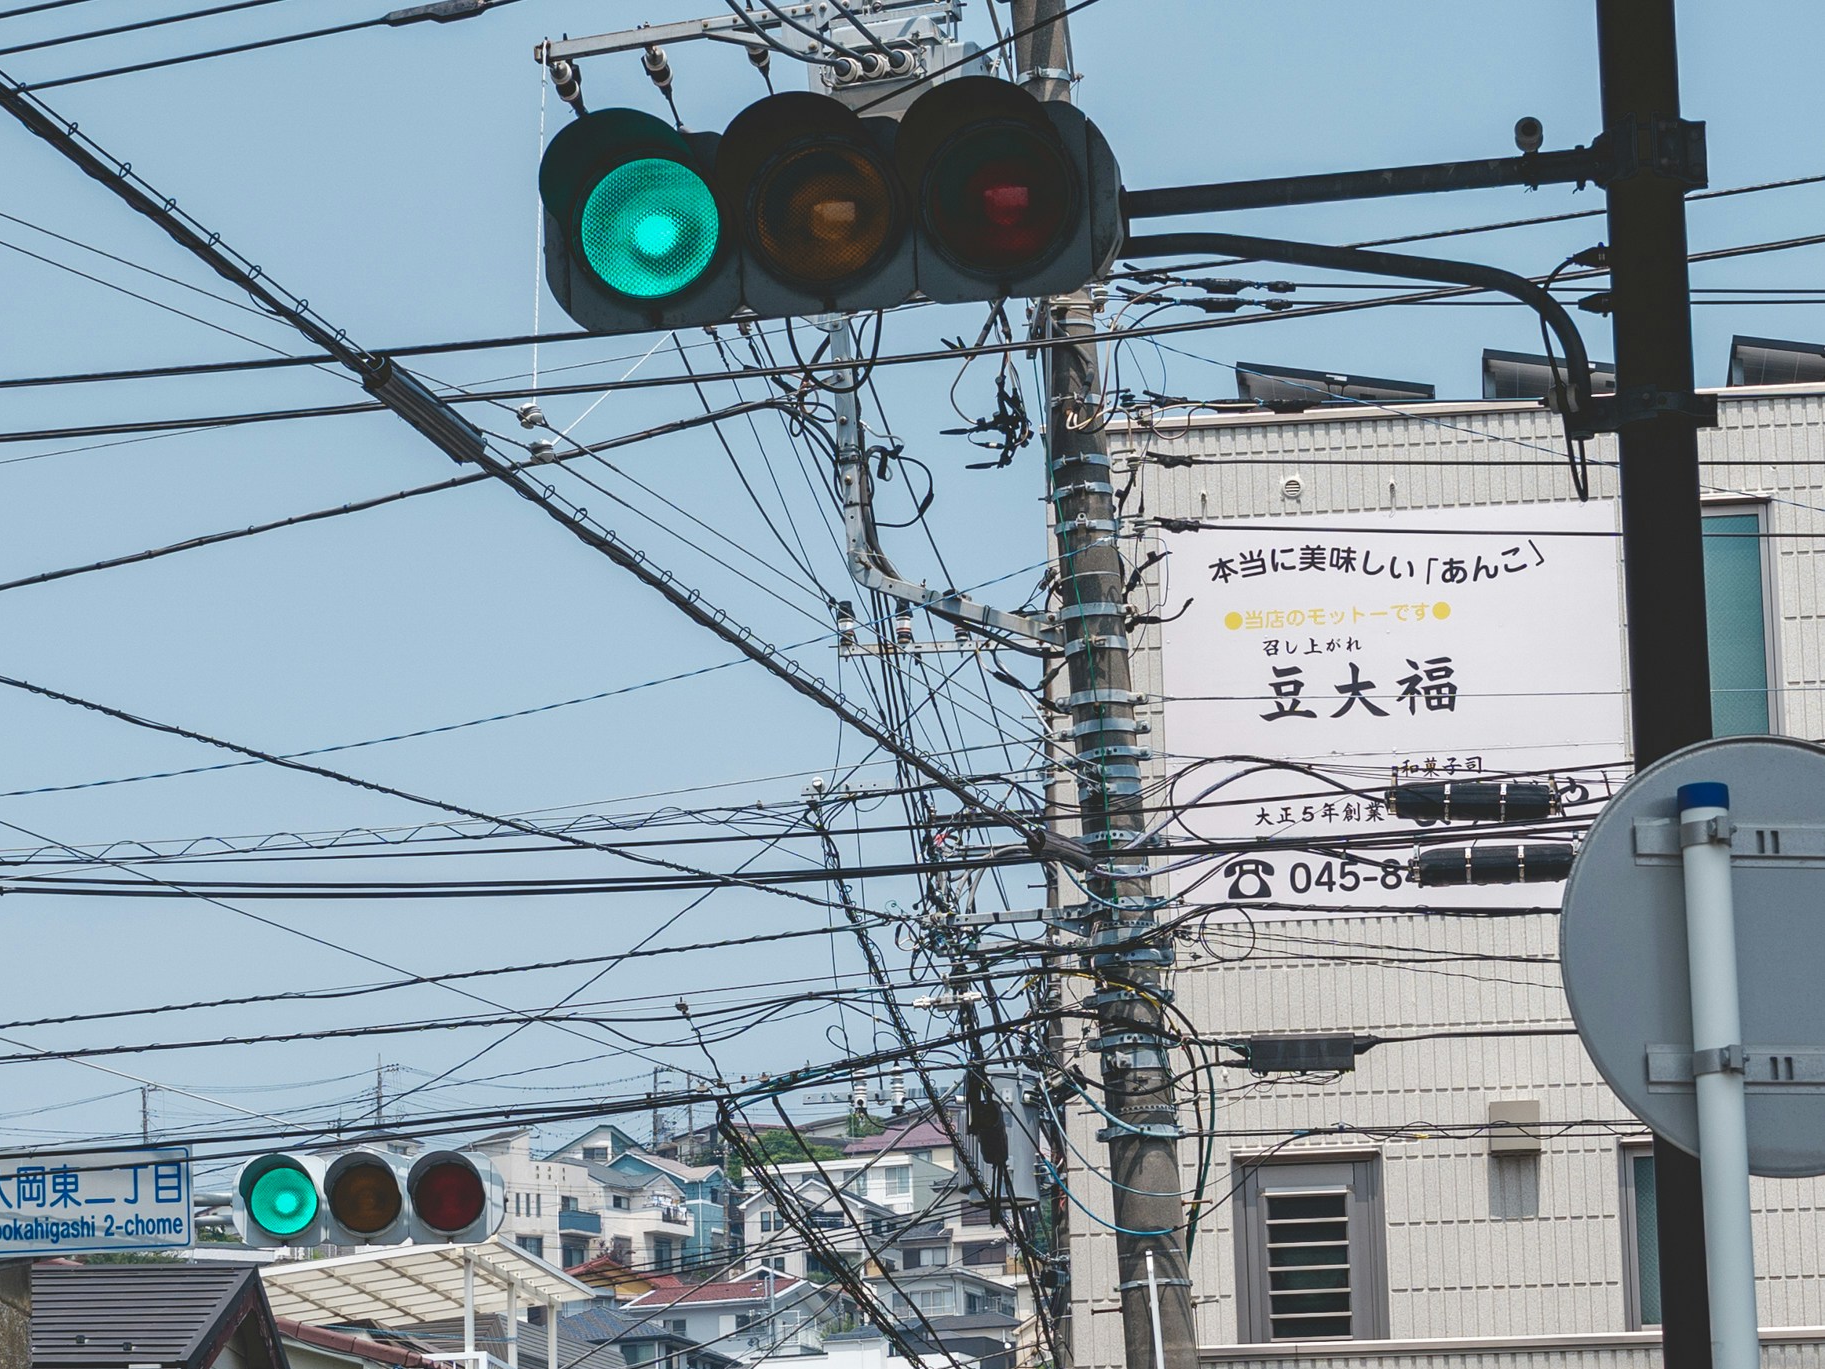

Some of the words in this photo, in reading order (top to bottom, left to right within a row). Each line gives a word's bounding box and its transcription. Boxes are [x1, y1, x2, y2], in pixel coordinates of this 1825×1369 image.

[1208, 540, 1545, 584] 本当に美味しい「あんこ」
[1245, 602, 1430, 630] 当店のモットーです
[1262, 636, 1362, 657] 召し上がれ
[1259, 656, 1458, 721] 豆大福
[1401, 756, 1483, 777] 和菓子司
[1255, 802, 1386, 825] 大正5年創業
[104, 1213, 183, 1237] 2-chome
